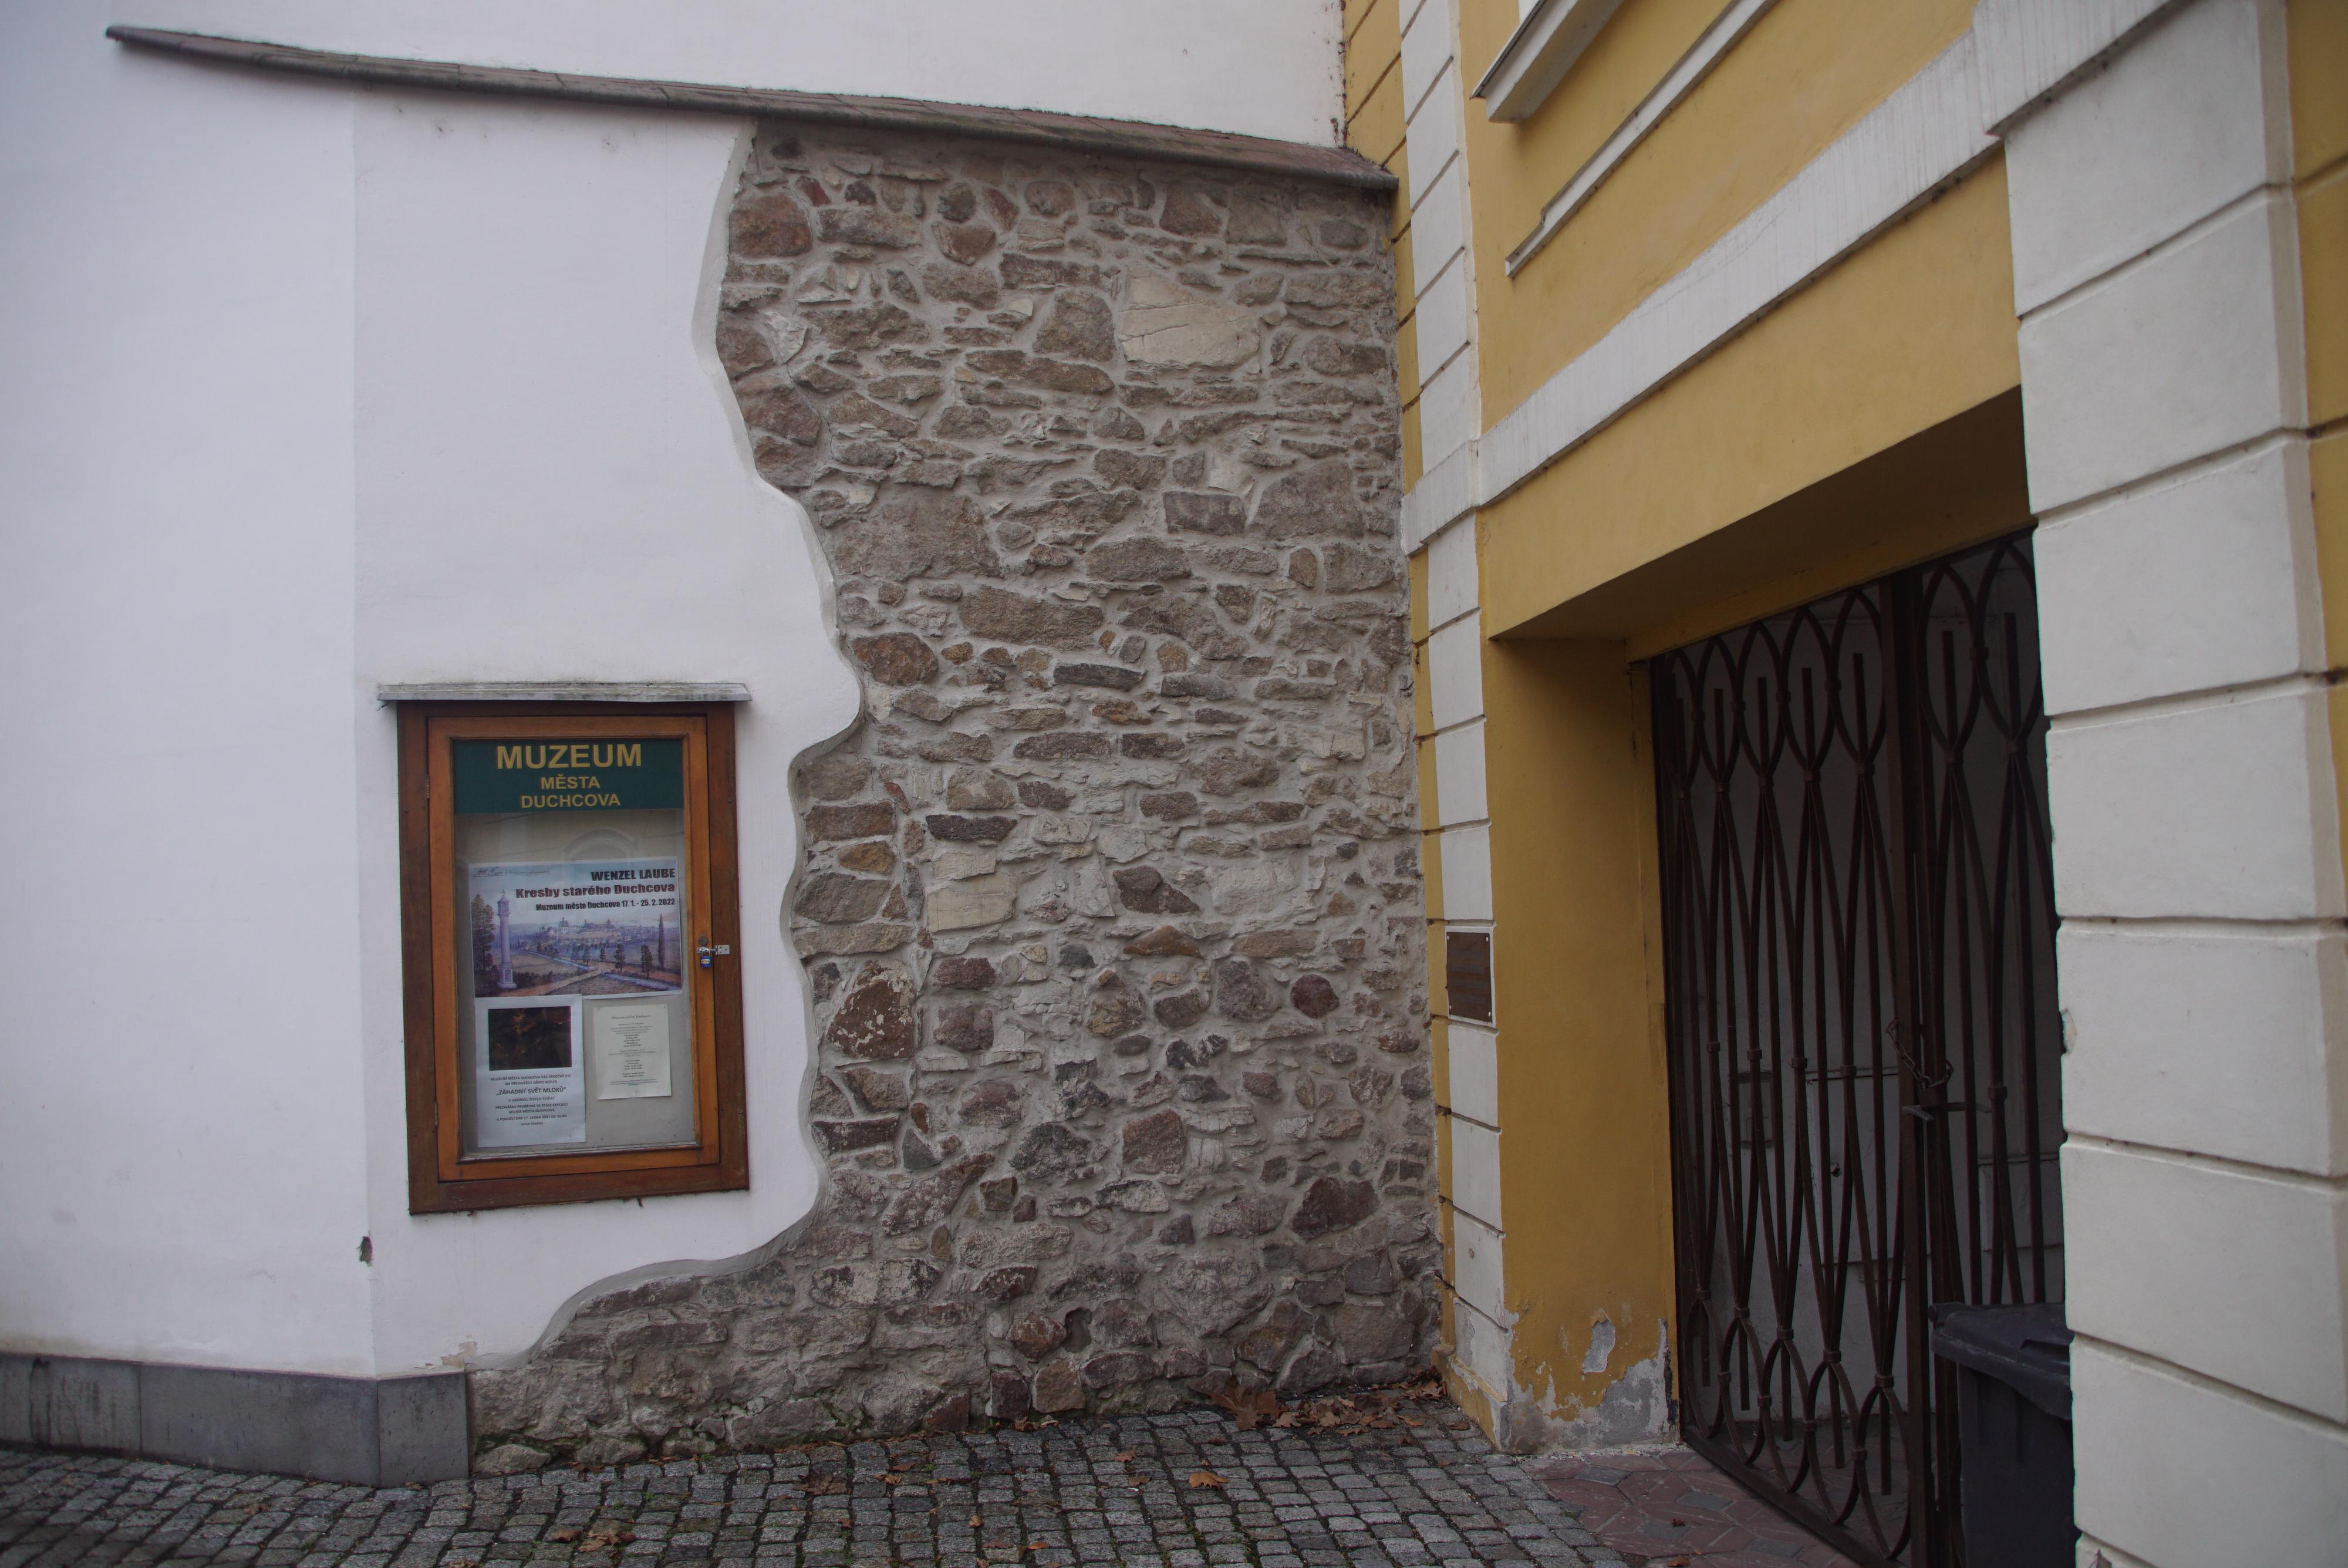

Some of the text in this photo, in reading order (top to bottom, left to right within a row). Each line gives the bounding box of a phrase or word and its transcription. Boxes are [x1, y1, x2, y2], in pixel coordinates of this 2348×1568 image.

[497, 744, 642, 769] MUZEUM
[541, 774, 601, 790] MĚSTA
[521, 794, 621, 808] DUCHCOVA
[591, 868, 675, 881] WENZEL LAUBE
[516, 883, 675, 898] Kresby starého Duchcova
[536, 903, 564, 911] Muzeum
[588, 901, 620, 909] Duchcova
